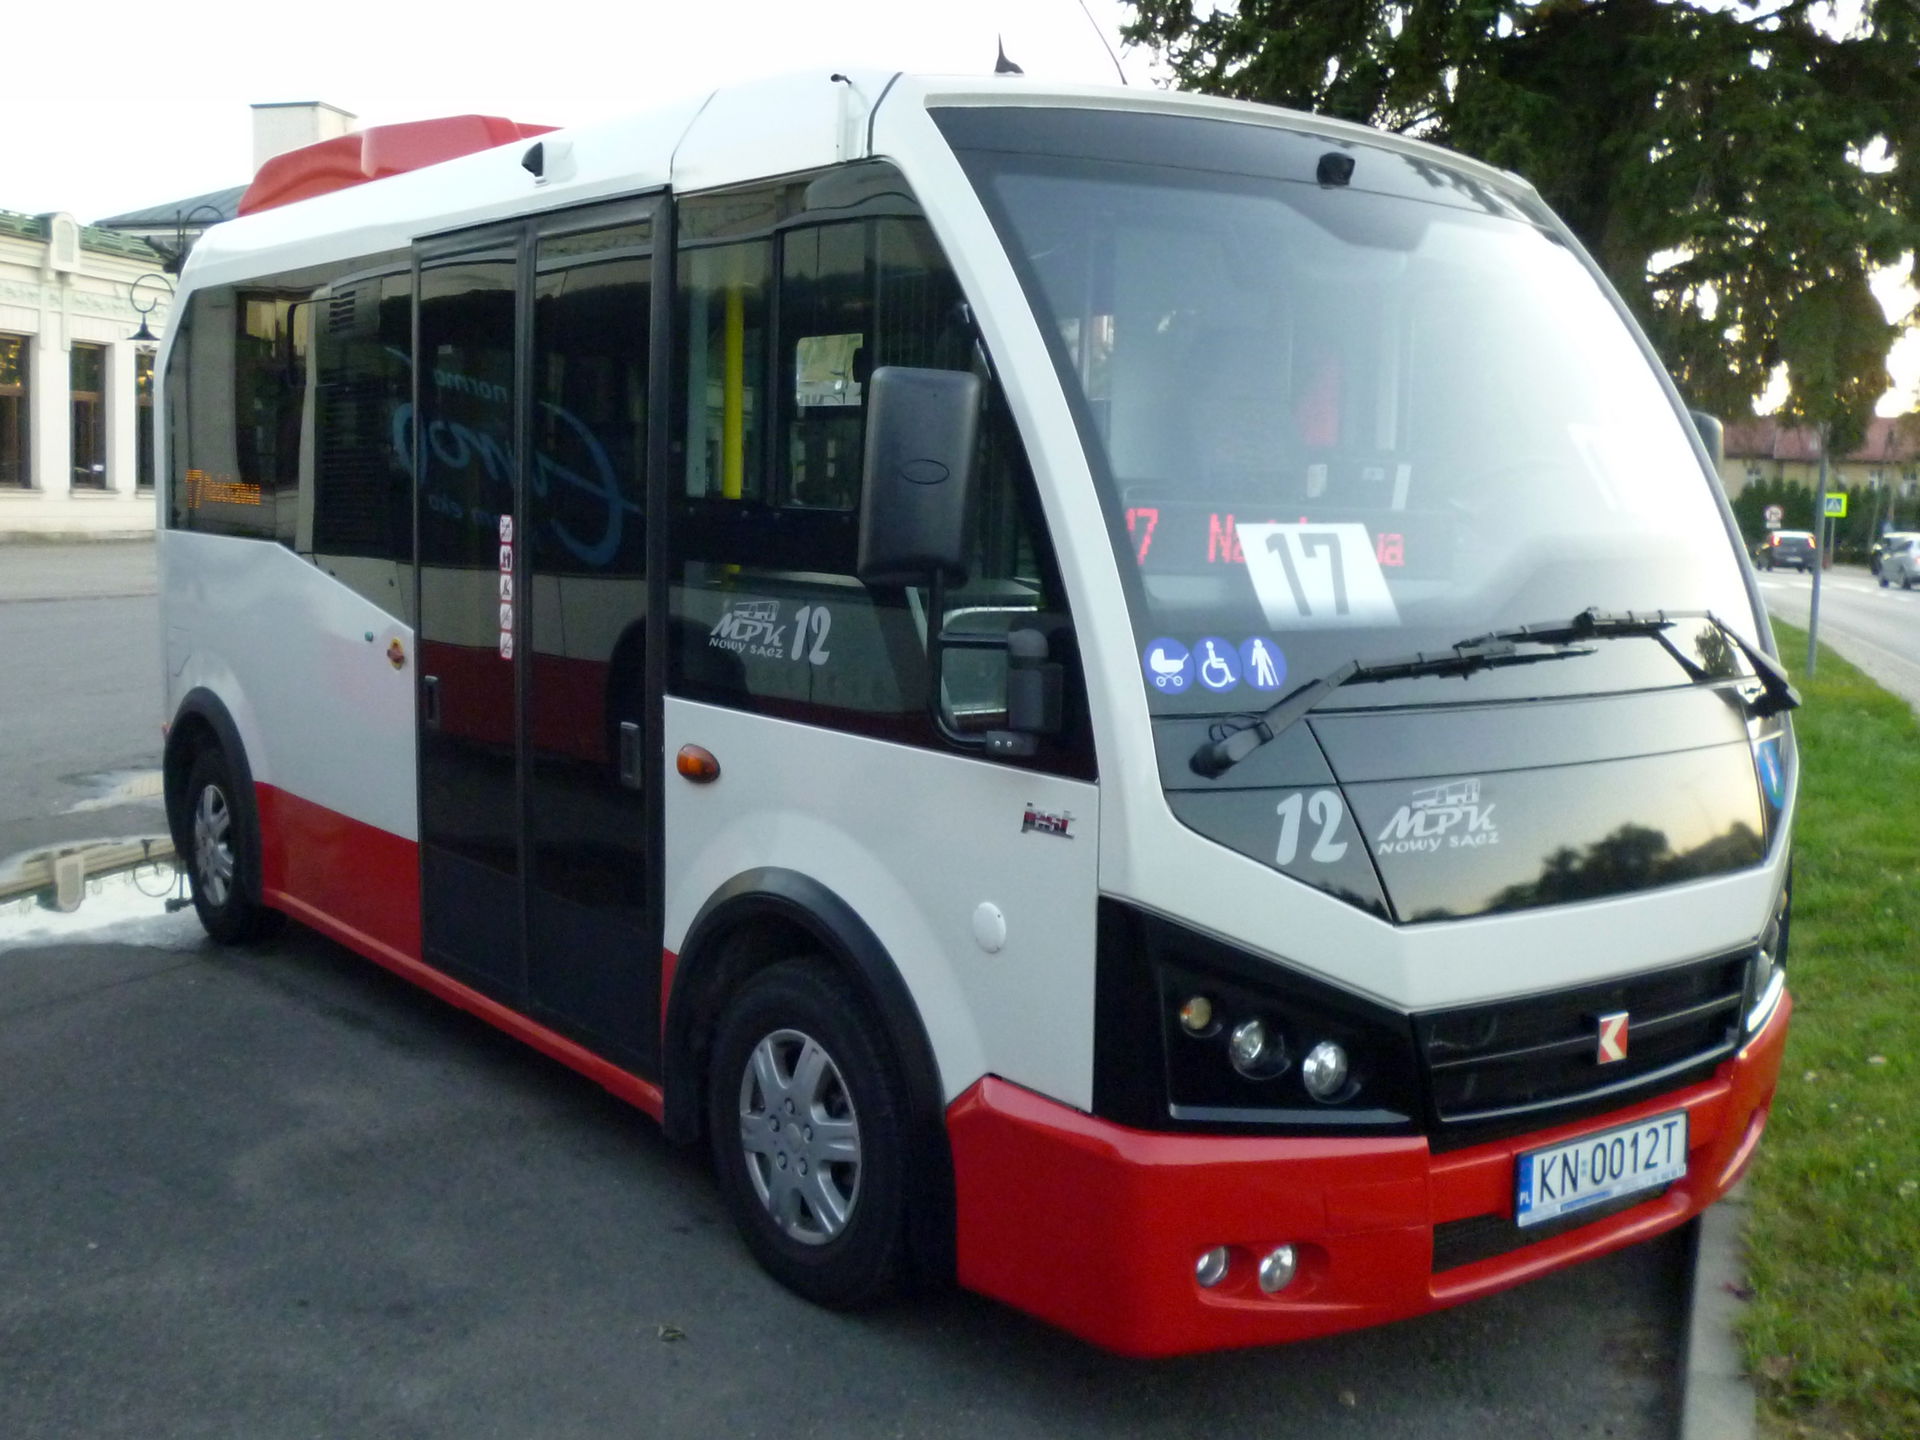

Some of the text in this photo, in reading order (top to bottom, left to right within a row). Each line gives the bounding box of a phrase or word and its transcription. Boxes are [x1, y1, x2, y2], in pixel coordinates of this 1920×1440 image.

[1265, 533, 1350, 616] 17
[708, 637, 746, 655] NOWY
[710, 612, 786, 647] MPK
[791, 606, 832, 666] 12
[1275, 790, 1348, 866] 12
[1378, 803, 1497, 842] MPK
[1378, 837, 1442, 856] NOWY
